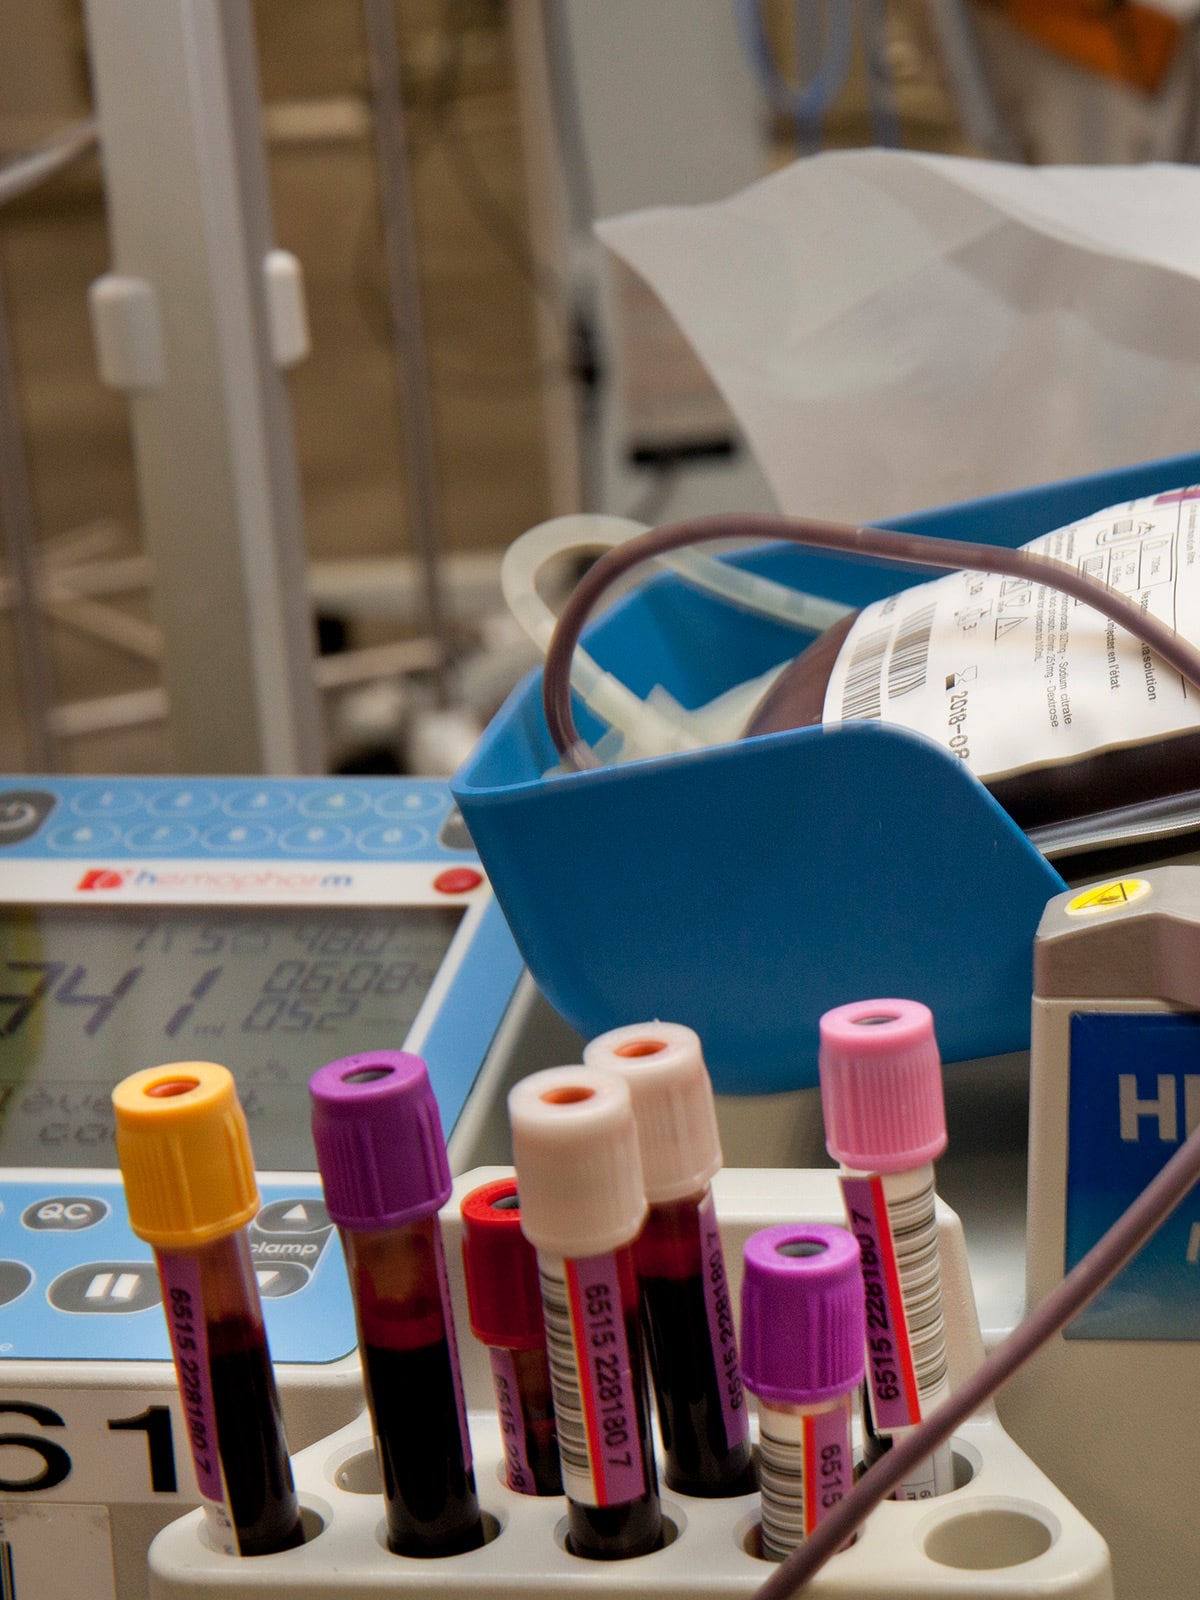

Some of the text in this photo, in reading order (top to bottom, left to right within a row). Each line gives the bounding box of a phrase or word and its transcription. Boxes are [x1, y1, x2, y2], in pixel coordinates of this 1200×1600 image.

[1058, 661, 1069, 690] Sodium
[1107, 651, 1116, 663] en
[1109, 664, 1121, 690] l'état
[1046, 685, 1059, 728] Dextrose
[1060, 693, 1073, 726] citrate
[37, 1203, 92, 1221] QC
[706, 1232, 743, 1410] 6515 228180 7
[852, 1209, 900, 1401] 6515 228180 7
[170, 1288, 212, 1476] 6515 228180 7
[585, 1283, 631, 1467] 6515 228180 7
[495, 1374, 526, 1489] 6515 228
[821, 1444, 844, 1508] 6515
